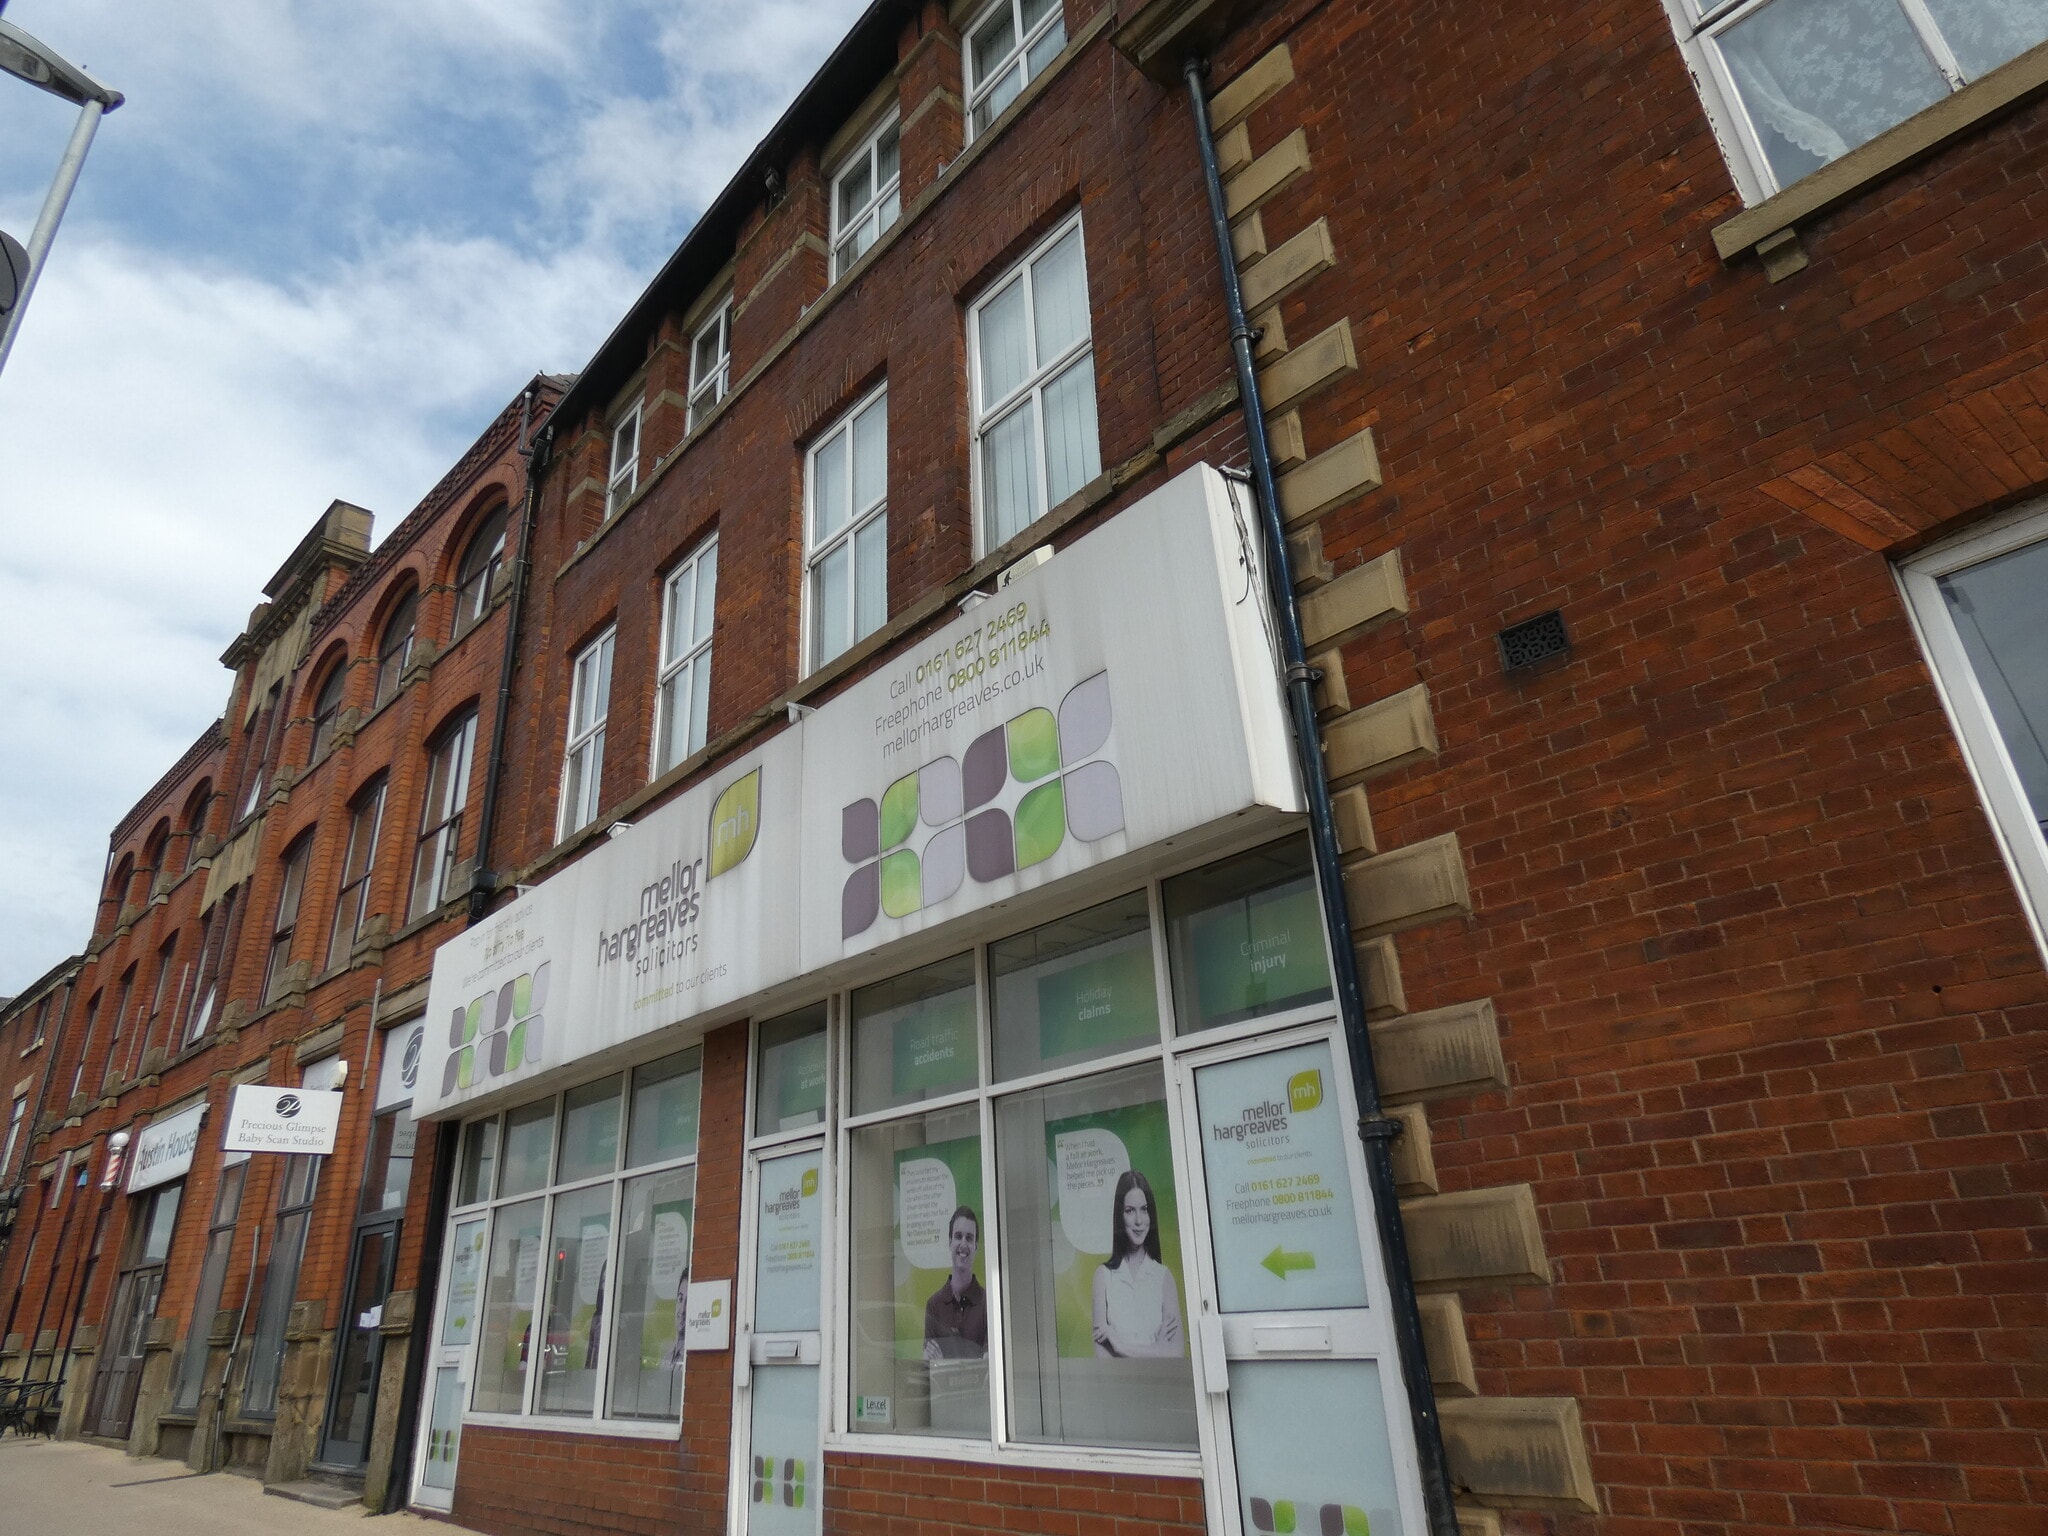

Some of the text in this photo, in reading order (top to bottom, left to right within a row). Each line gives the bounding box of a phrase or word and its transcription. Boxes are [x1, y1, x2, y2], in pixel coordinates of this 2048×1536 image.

[889, 601, 1028, 699] Call 0161 627 2469
[874, 618, 1051, 736] Freephone 0800 811844
[882, 653, 1045, 759] mellorhargreaves.co.uk
[717, 805, 749, 848] mh
[639, 858, 703, 916] mellor
[597, 892, 701, 968] hargreaves
[1240, 928, 1291, 956] Criminal
[635, 933, 698, 977] solicitors
[1250, 953, 1286, 974] injury
[633, 964, 727, 1010] committed to our clients
[1076, 985, 1113, 1005] Holiday
[1078, 1004, 1111, 1021] claims
[914, 1046, 954, 1066] accidents
[1293, 1082, 1316, 1099] mh
[1242, 1100, 1285, 1122] mellor
[241, 1119, 326, 1134] Precious Glimpse
[1213, 1117, 1288, 1142] hargreaves
[165, 1129, 197, 1162] House
[238, 1132, 324, 1146] Baby Scan Studio
[1245, 1135, 1290, 1150] solicitors
[1235, 1174, 1320, 1194] Call 0161 627 2469
[1226, 1188, 1334, 1211] Freephone 0800 811844
[1232, 1204, 1332, 1225] mellorhargreaves.co.uk
